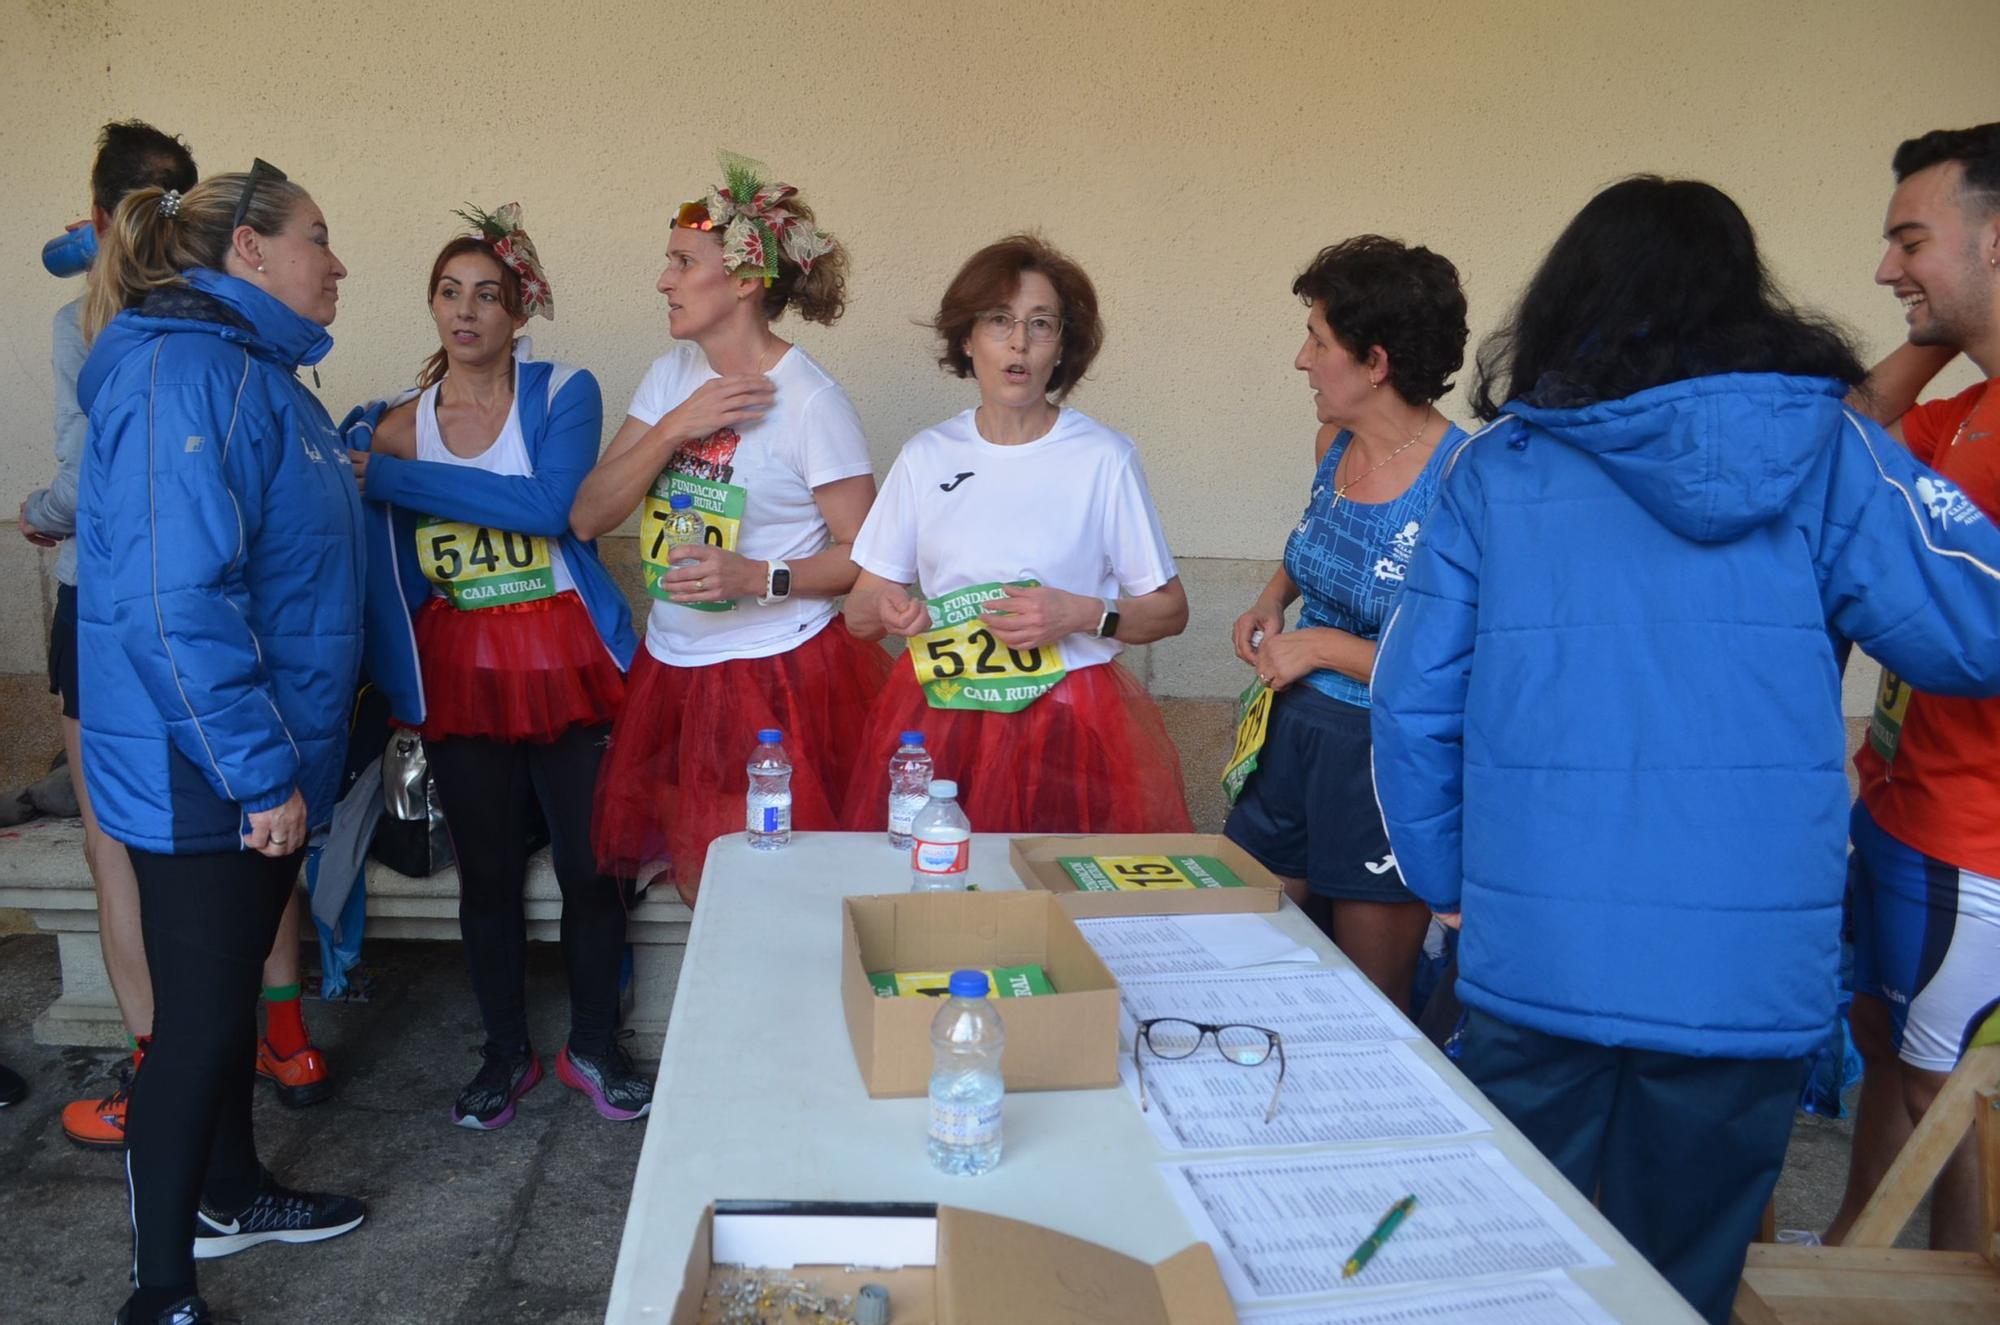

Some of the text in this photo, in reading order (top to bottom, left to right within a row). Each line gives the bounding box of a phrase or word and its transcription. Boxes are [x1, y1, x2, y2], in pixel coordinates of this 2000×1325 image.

[671, 478, 728, 502] FUNDACION
[694, 496, 724, 512] RURAL
[431, 528, 533, 579] 540
[462, 578, 546, 600] CAJA RURAL
[943, 588, 1010, 612] FUNDACI
[946, 604, 977, 623] CAJA
[927, 629, 1042, 678] 520
[963, 686, 1002, 701] CAJA
[1114, 863, 1183, 887] 15
